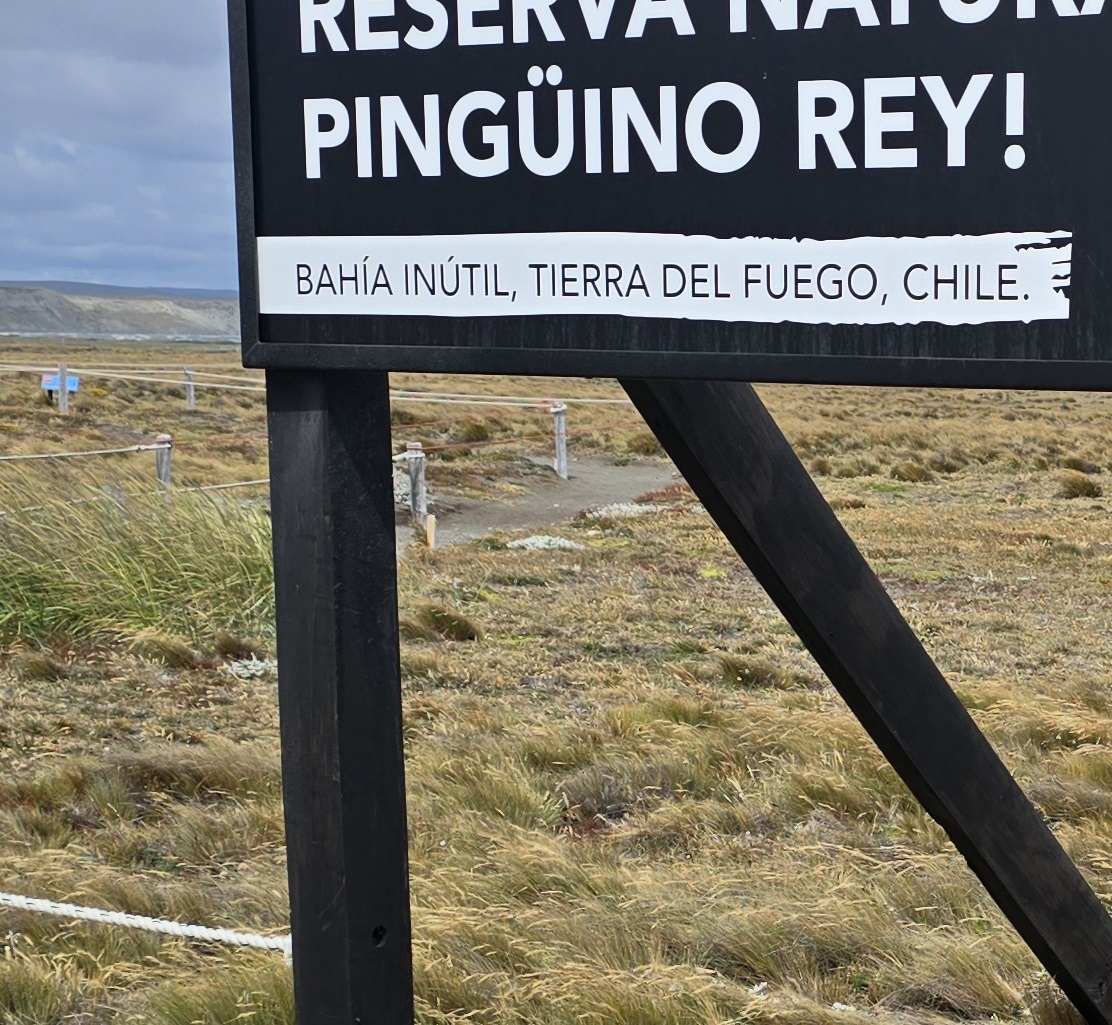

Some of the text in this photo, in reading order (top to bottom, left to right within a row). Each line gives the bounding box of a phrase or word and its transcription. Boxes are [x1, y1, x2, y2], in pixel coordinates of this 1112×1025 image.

[303, 64, 1026, 179] PINGÜINO REY!
[296, 255, 1030, 306] BAHÍA INÚTIL, TIERRA DEL FUEGO, CHILE.
